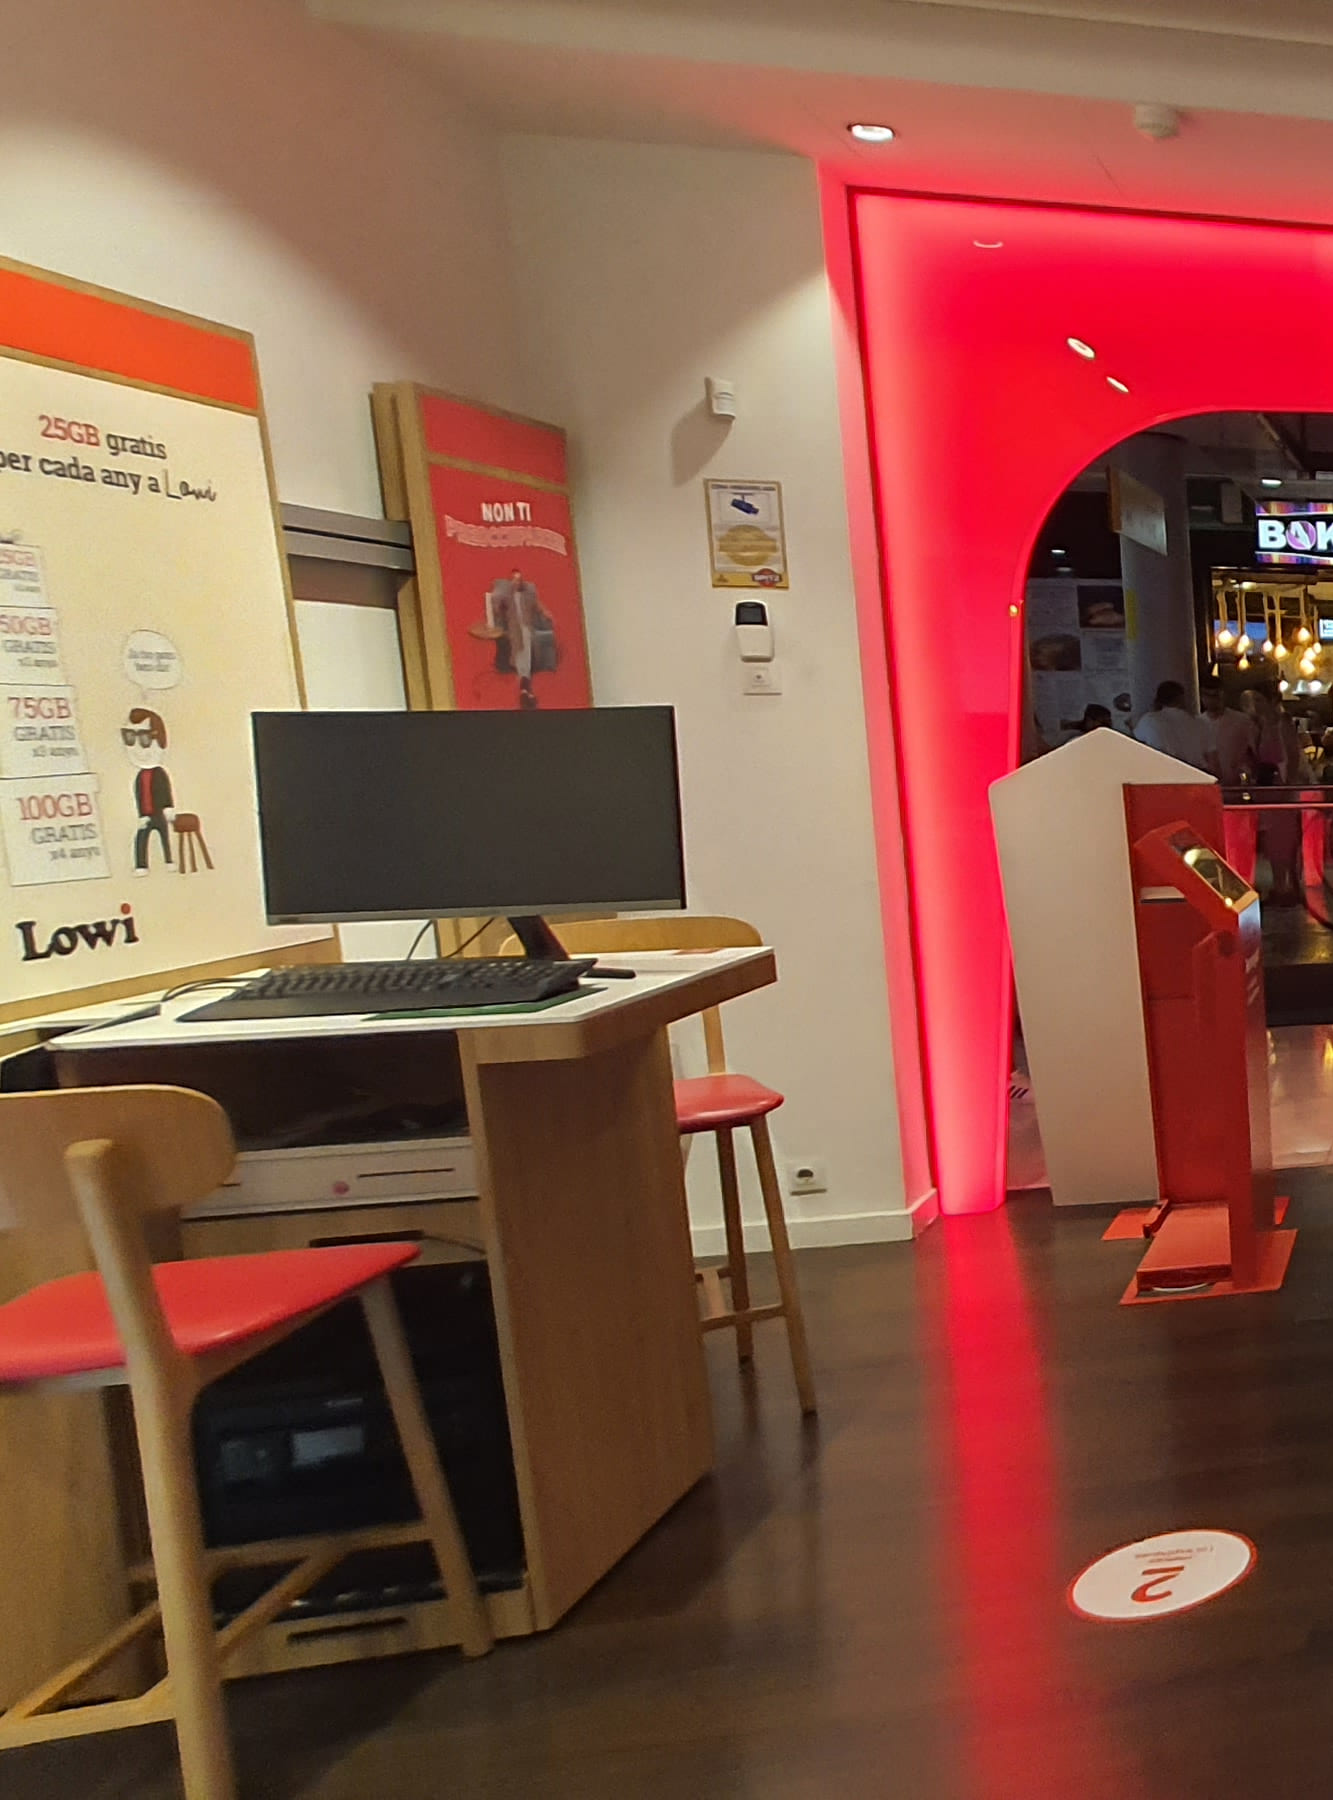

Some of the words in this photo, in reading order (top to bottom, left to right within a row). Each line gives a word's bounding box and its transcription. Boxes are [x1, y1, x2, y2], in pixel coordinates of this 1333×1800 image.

[38, 414, 101, 447] 25GB
[106, 433, 168, 460] gratis
[38, 456, 97, 484] cada
[101, 466, 142, 496] any
[147, 475, 162, 494] a
[481, 501, 515, 523] NON
[516, 501, 532, 522] TI
[8, 696, 73, 719] 75GB
[16, 793, 93, 822] 100GB
[15, 902, 140, 962] Lowi
[1130, 1565, 1185, 1604] 2
